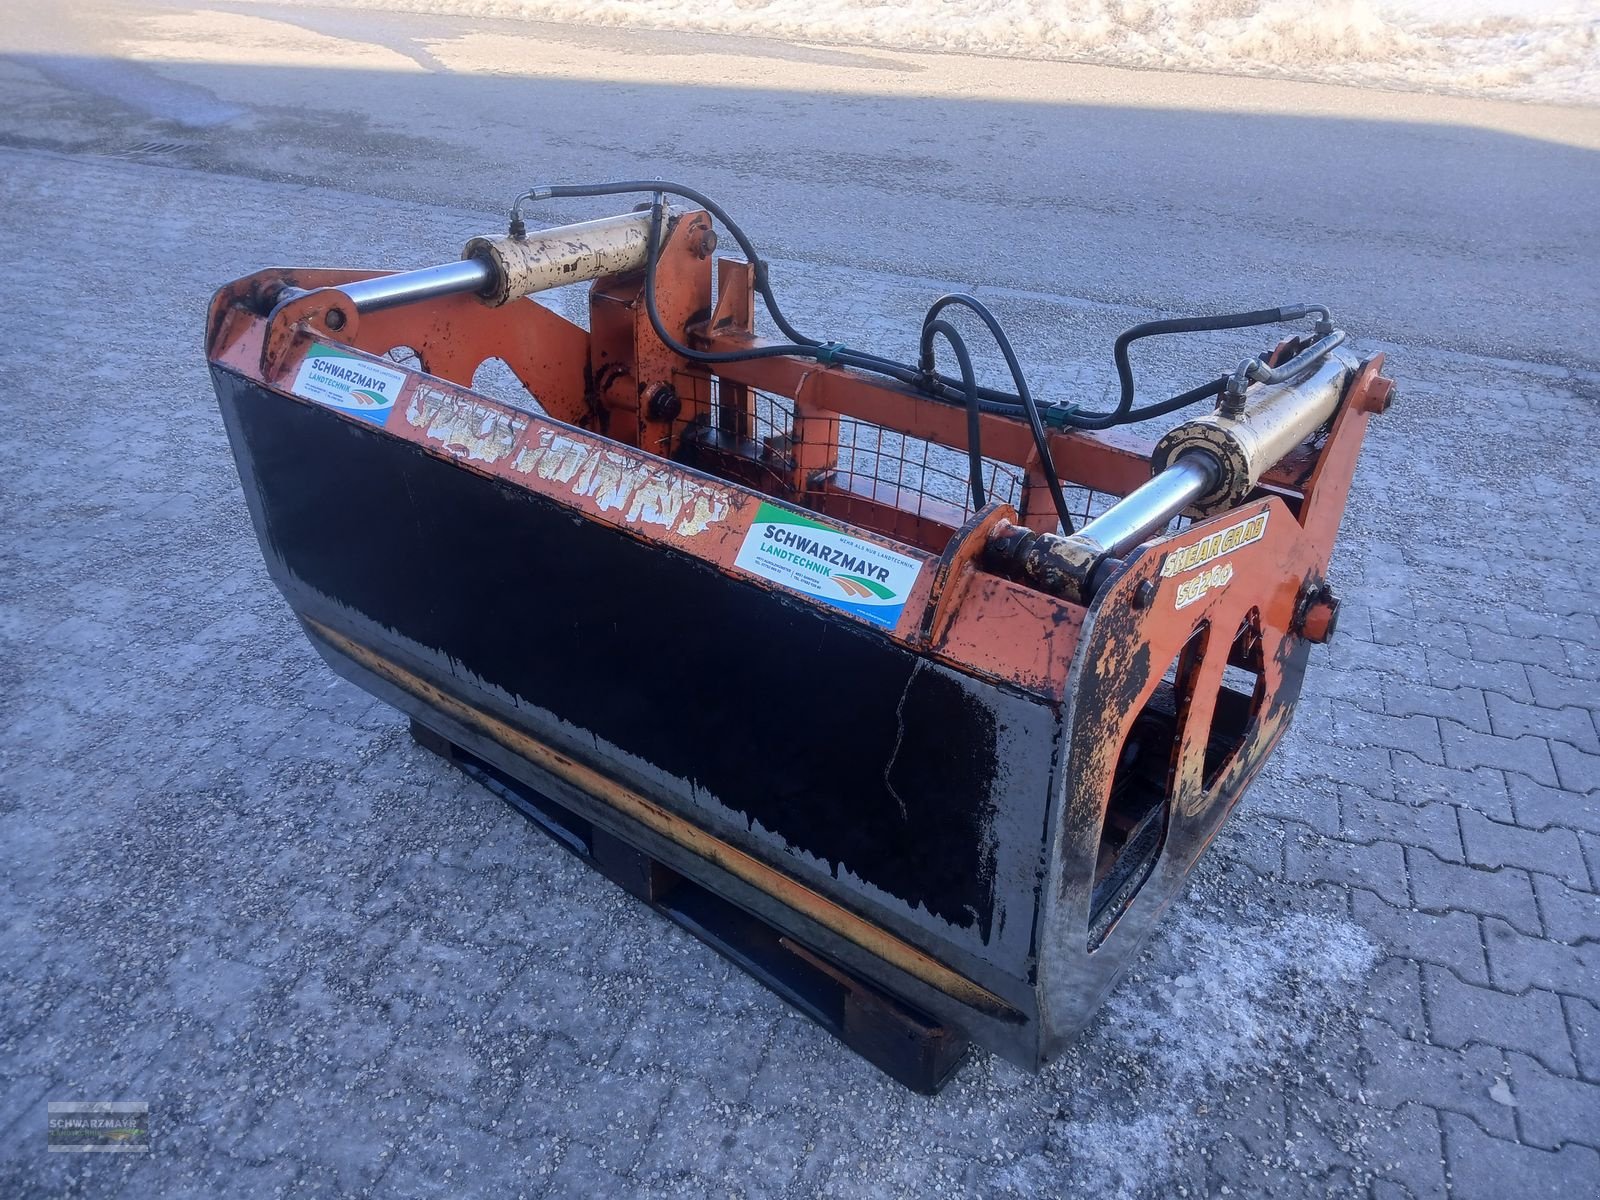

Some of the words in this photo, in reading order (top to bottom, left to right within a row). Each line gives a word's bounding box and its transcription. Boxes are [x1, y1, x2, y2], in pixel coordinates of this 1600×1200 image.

[308, 372, 351, 392] LANDTECHNIK
[312, 359, 386, 392] SCHWARZMAYR
[763, 524, 890, 583] SCHWARZMAYR
[840, 538, 854, 546] MEHR
[1163, 534, 1222, 577] SHEAR
[1221, 516, 1265, 552] GRAB
[760, 542, 832, 577] LANDTECHNIK
